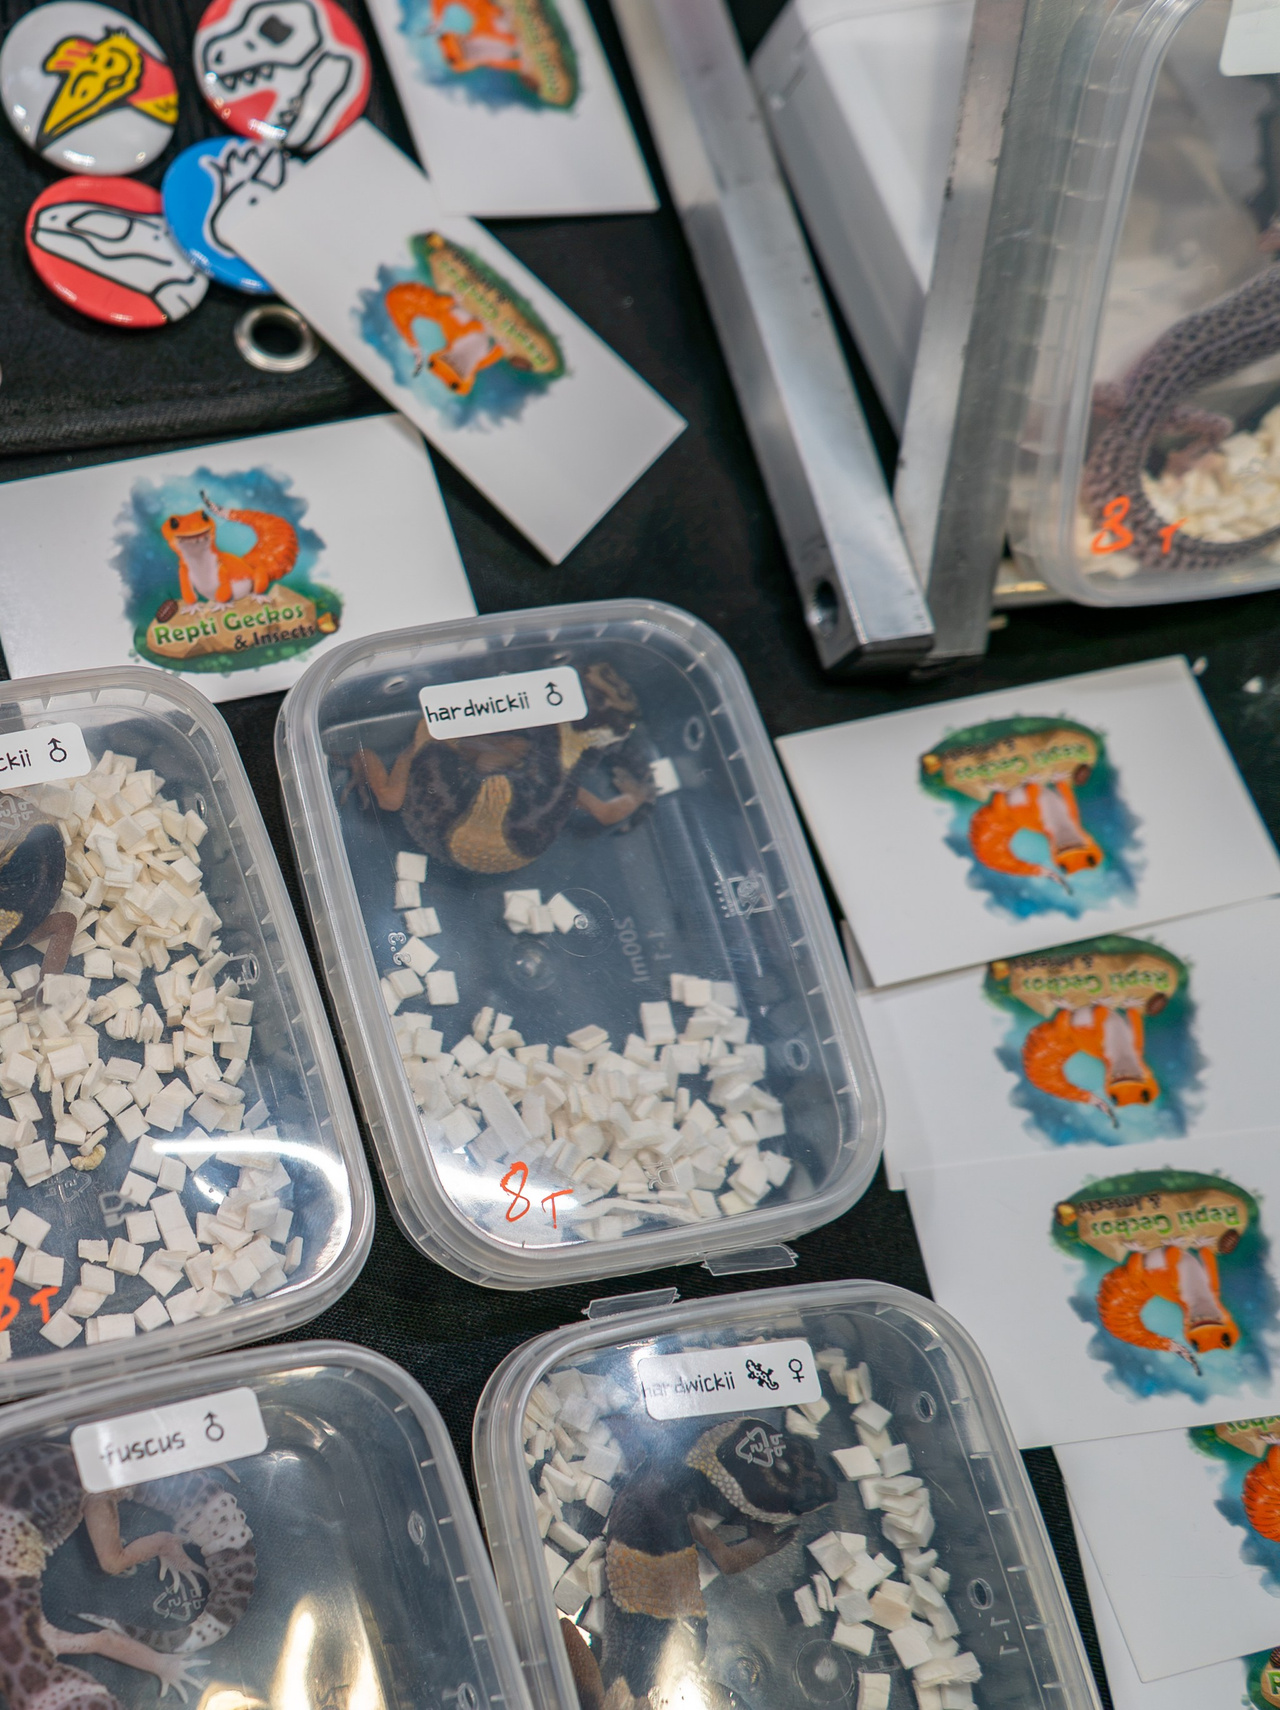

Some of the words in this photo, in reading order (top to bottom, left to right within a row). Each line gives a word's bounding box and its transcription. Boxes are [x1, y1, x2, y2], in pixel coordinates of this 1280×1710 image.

[154, 617, 217, 645] Repti
[223, 604, 303, 631] Geckos
[233, 634, 249, 651] &
[252, 624, 315, 647] Insects
[424, 691, 530, 723] hardwickii
[1091, 1212, 1173, 1239] Geckos
[1176, 1203, 1241, 1231] Repti
[99, 1431, 186, 1465] fuscus
